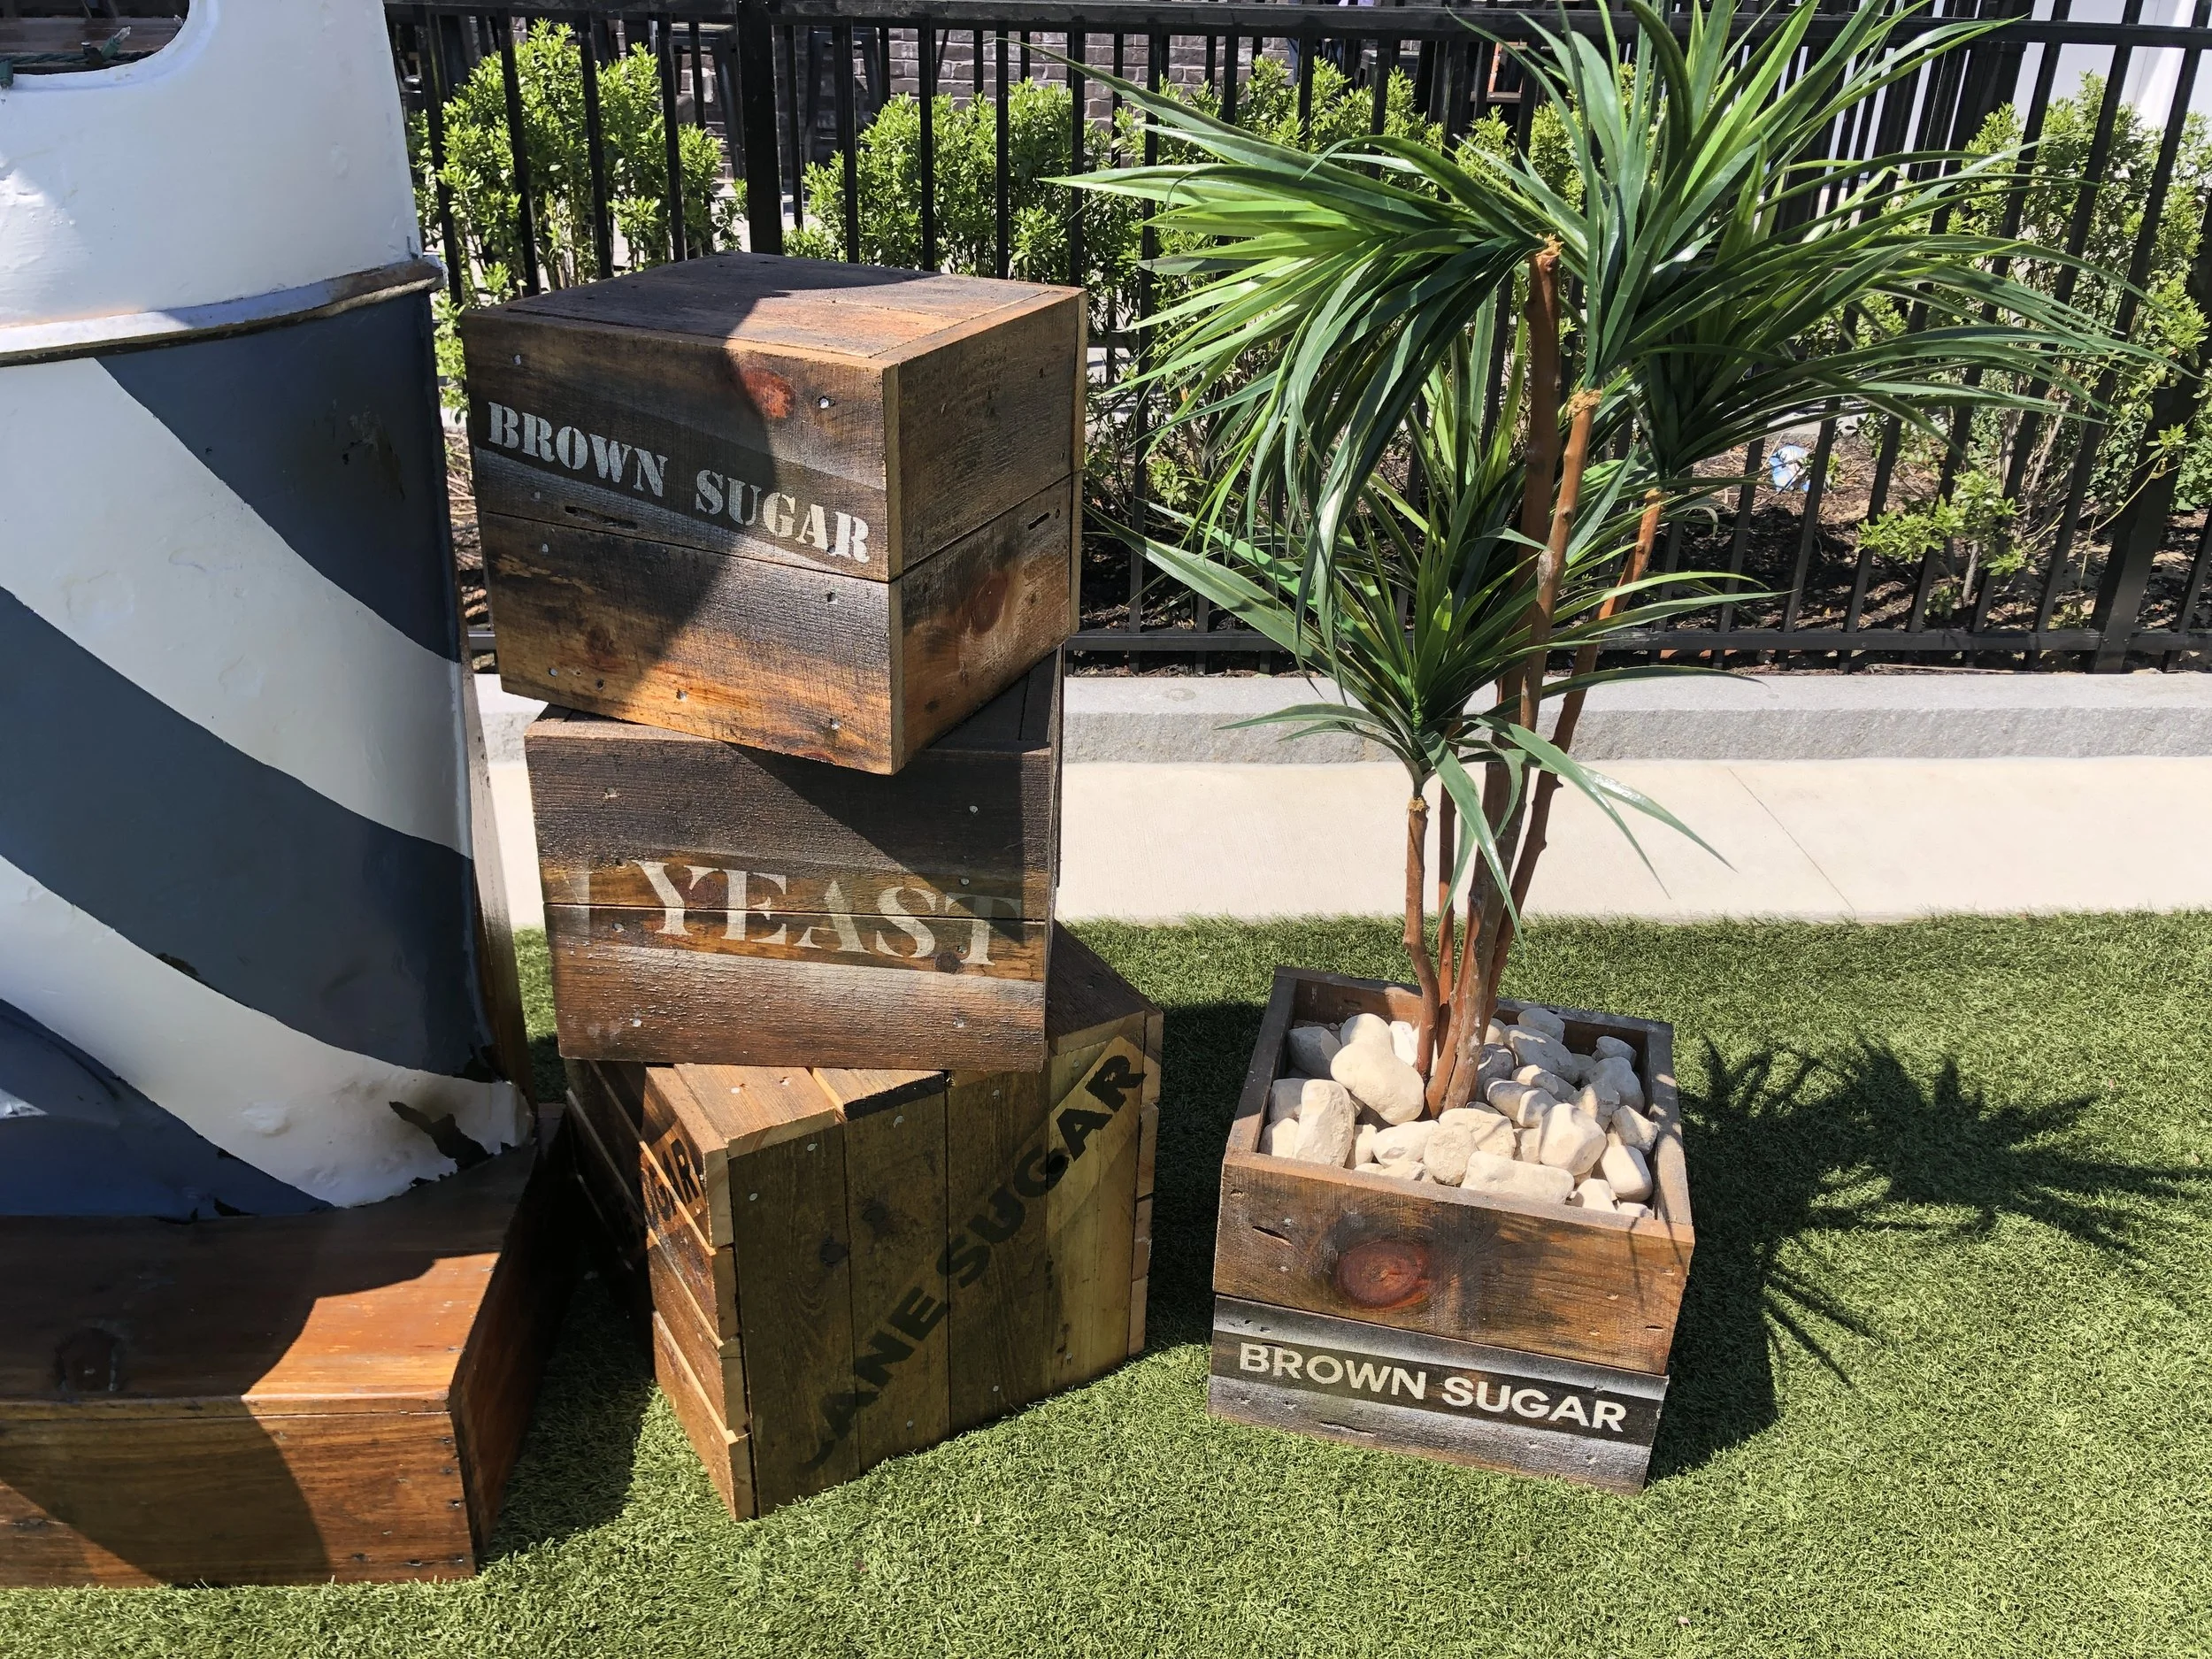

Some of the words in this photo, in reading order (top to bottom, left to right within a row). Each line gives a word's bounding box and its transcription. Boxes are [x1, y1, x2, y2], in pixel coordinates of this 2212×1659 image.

[488, 401, 669, 498] BROWN
[695, 469, 871, 564] SUGAR
[629, 858, 1023, 966] YEAST
[796, 1286, 950, 1474] ANE
[935, 1054, 1148, 1289] SUGAR
[1239, 1341, 1426, 1401] BROWN
[1441, 1376, 1627, 1432] SUGAR
